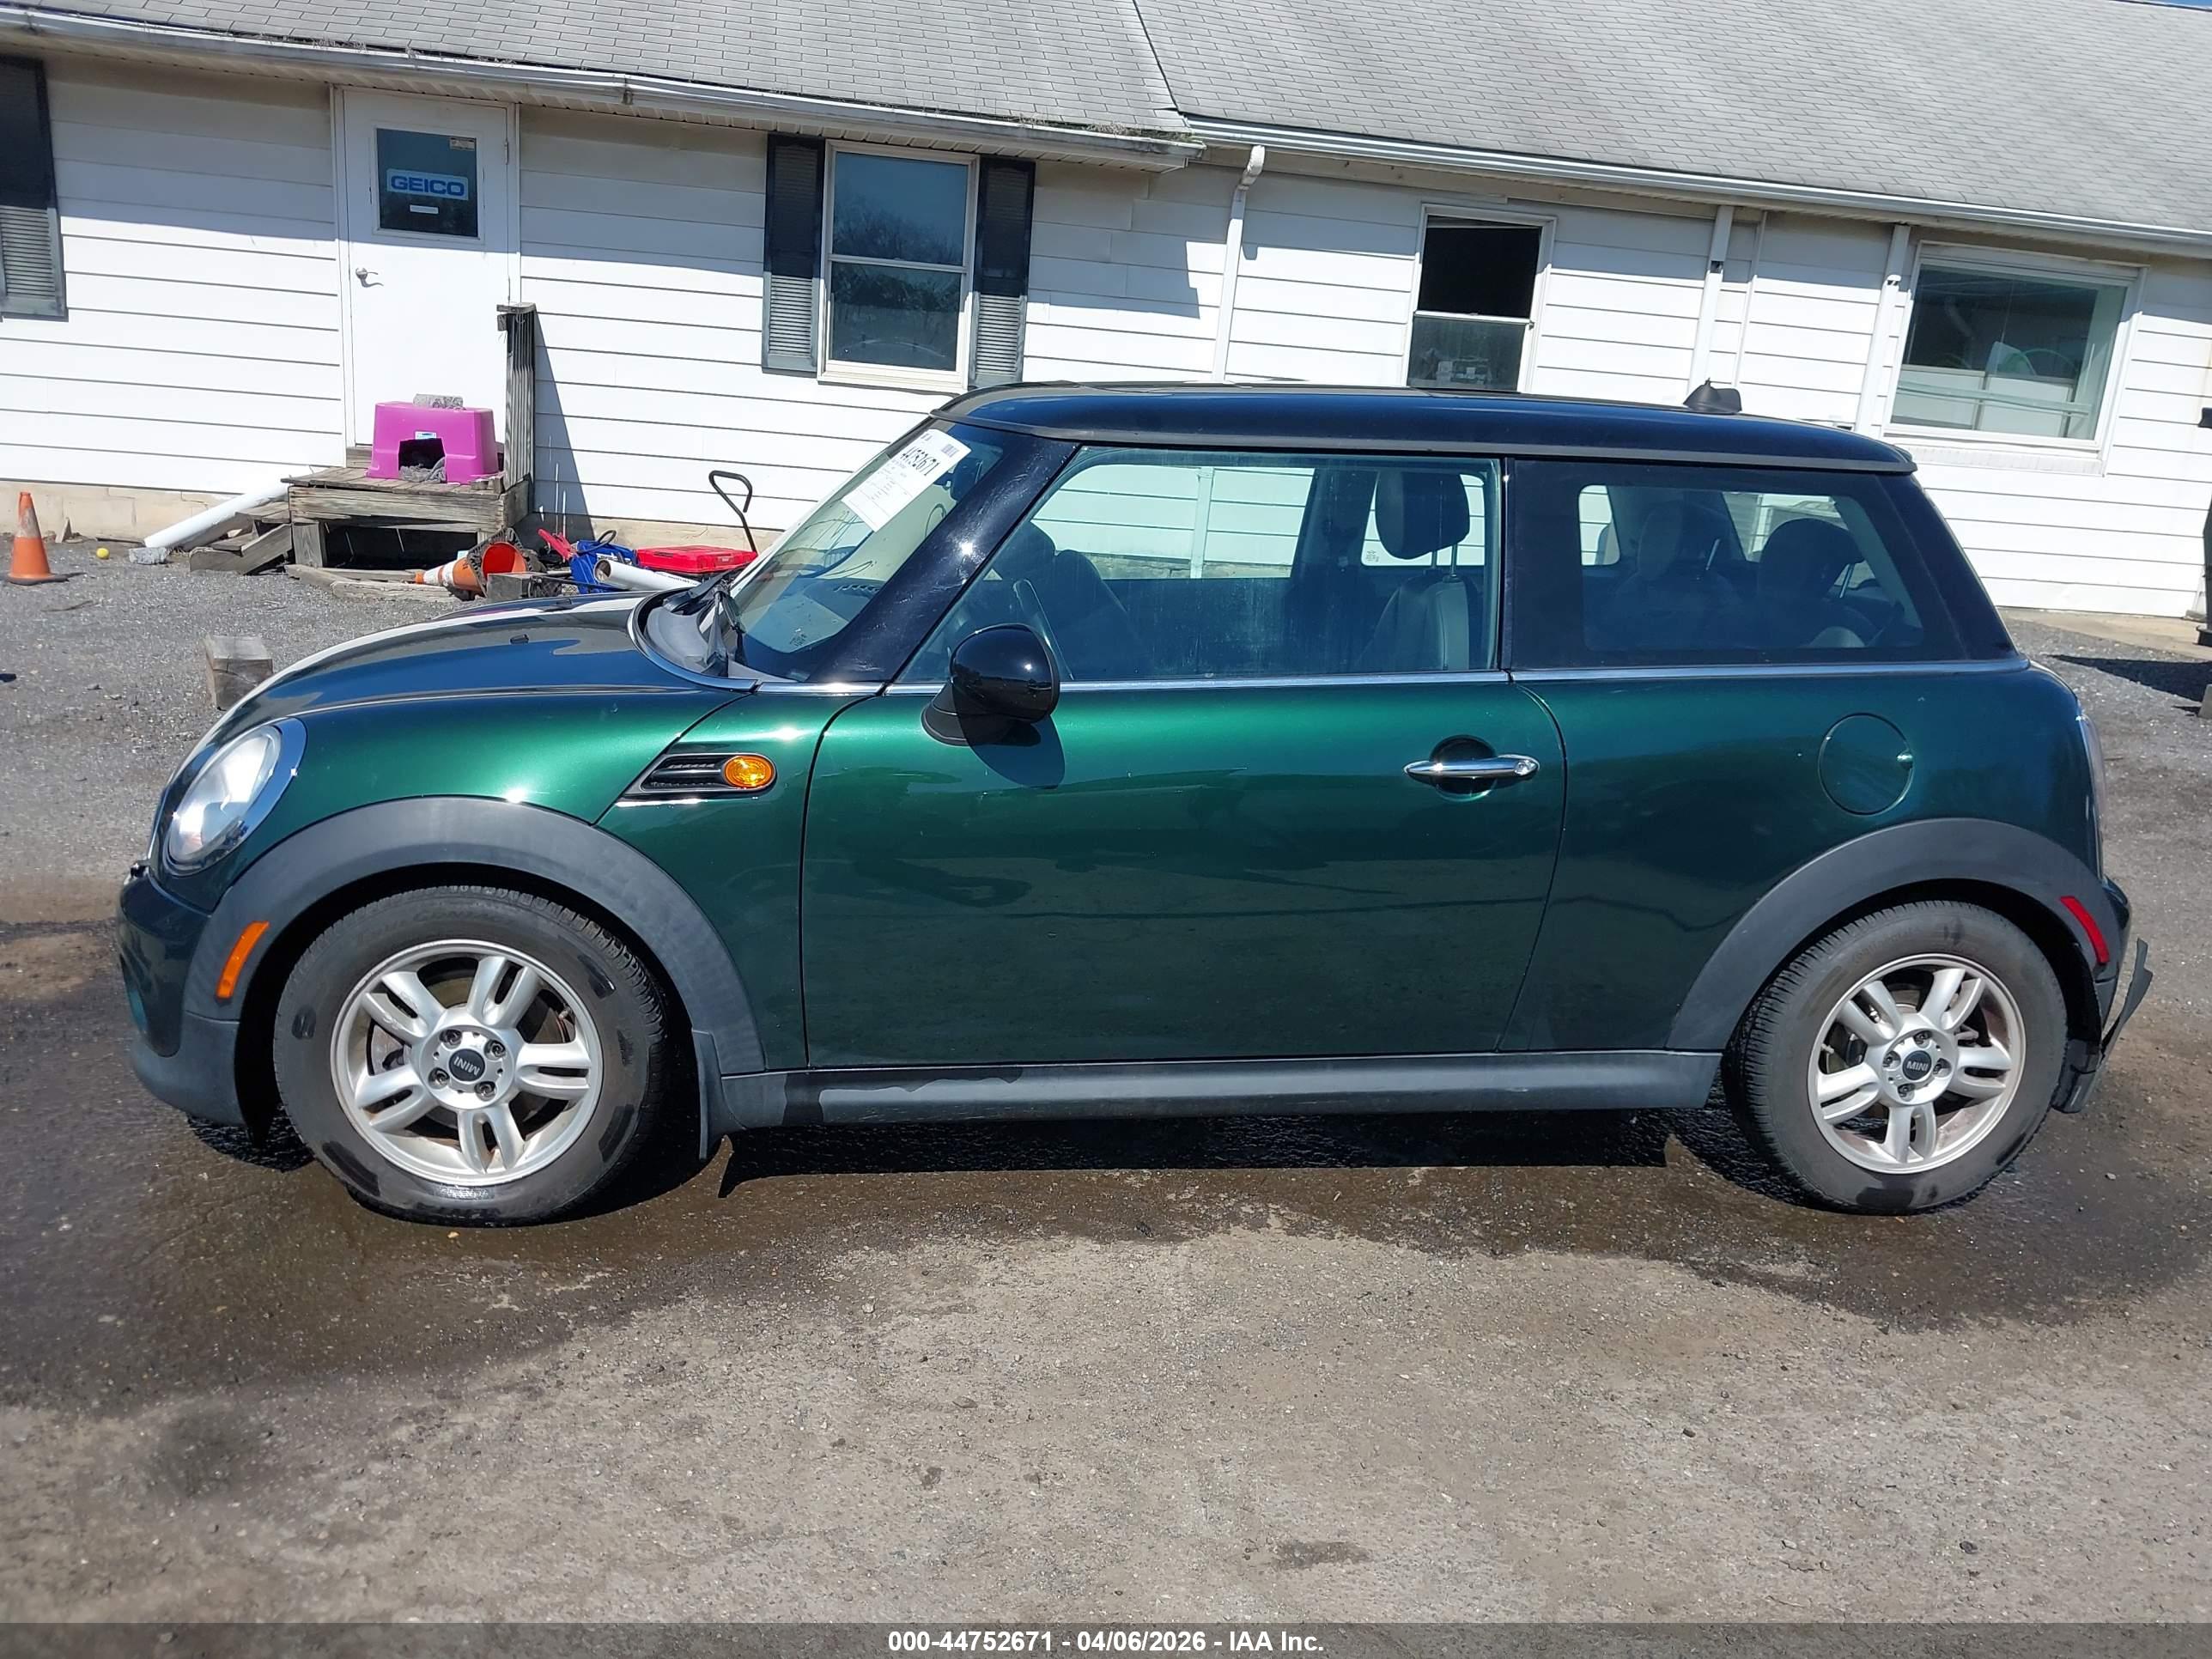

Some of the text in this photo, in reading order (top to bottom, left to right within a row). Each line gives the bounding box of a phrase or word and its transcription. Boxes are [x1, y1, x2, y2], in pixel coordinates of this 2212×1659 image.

[391, 175, 465, 196] GEICO
[453, 1056, 480, 1076] MINI
[1906, 1060, 1929, 1073] MINI
